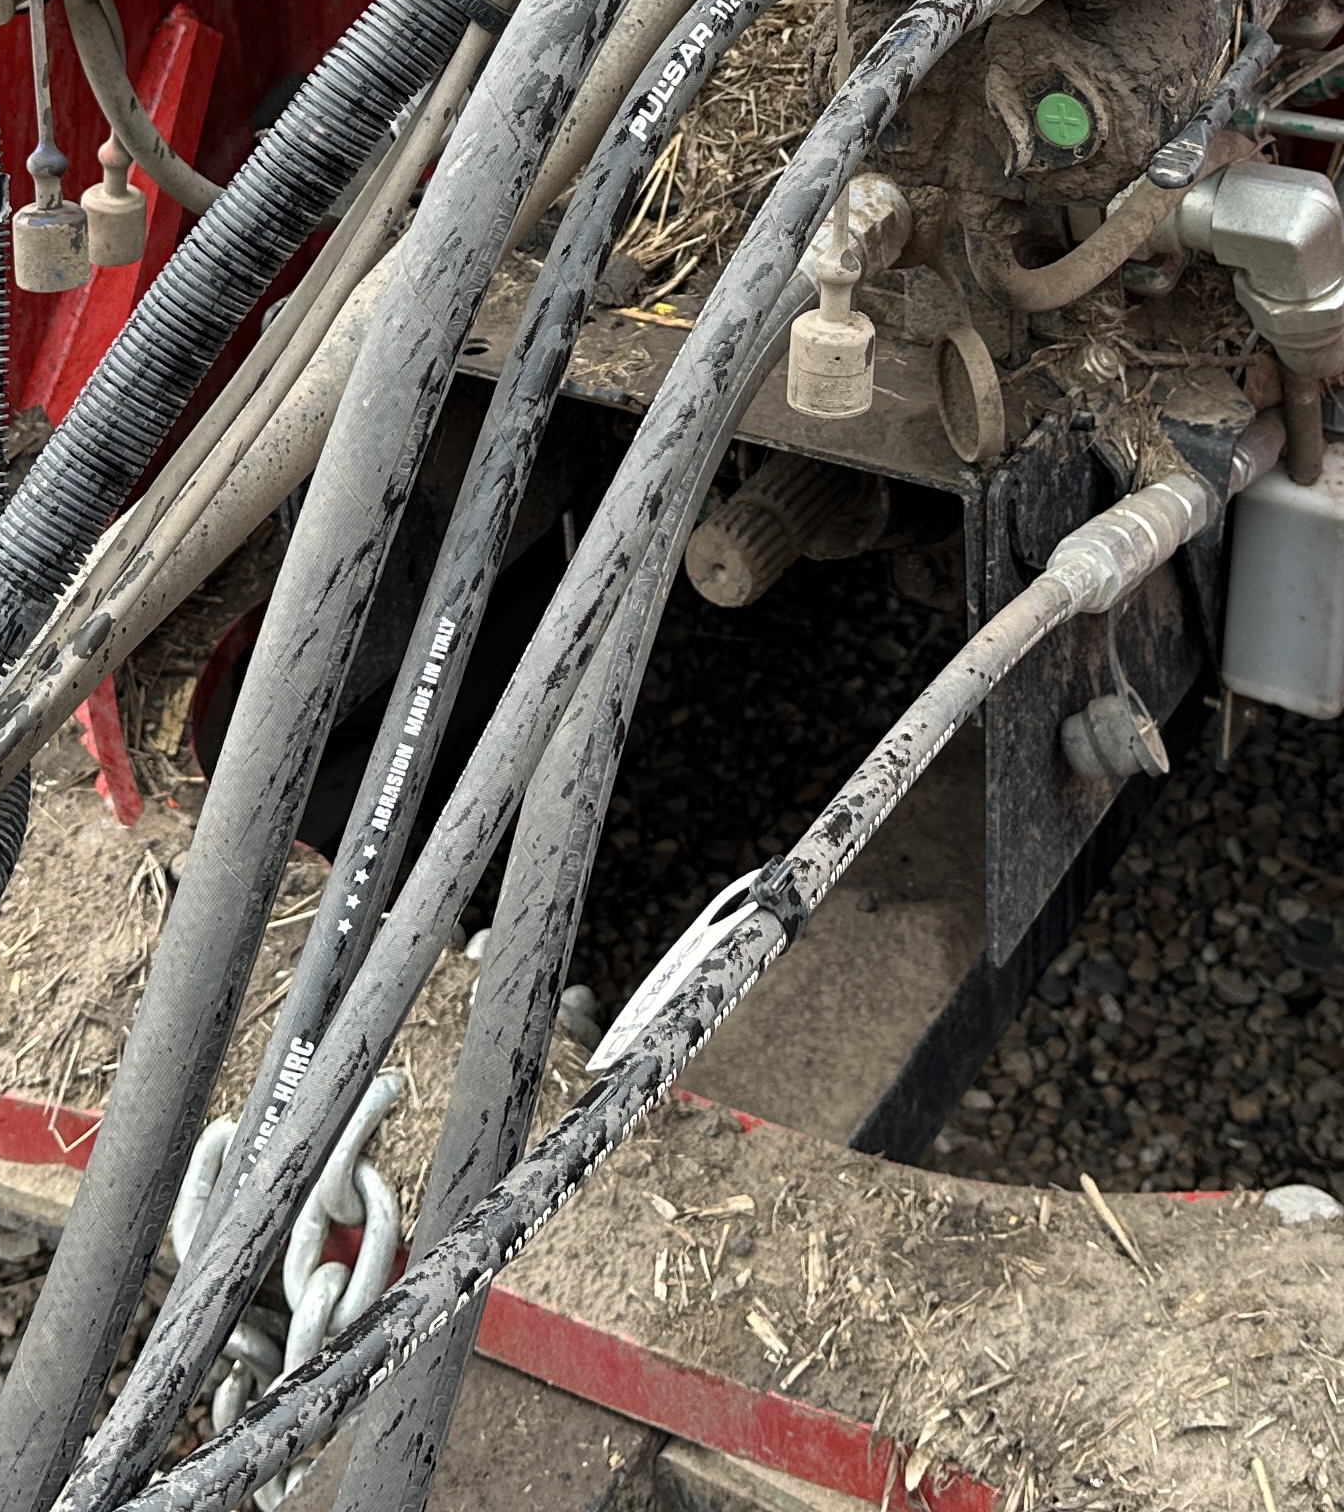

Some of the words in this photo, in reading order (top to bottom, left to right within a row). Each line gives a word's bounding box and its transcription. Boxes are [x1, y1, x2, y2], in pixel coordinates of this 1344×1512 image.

[629, 21, 713, 142] PULSAR
[429, 616, 457, 660] ITALY
[421, 661, 442, 685] IN
[404, 685, 434, 737] MADE
[370, 742, 415, 832] ABRASION
[273, 1035, 316, 1105] HARC
